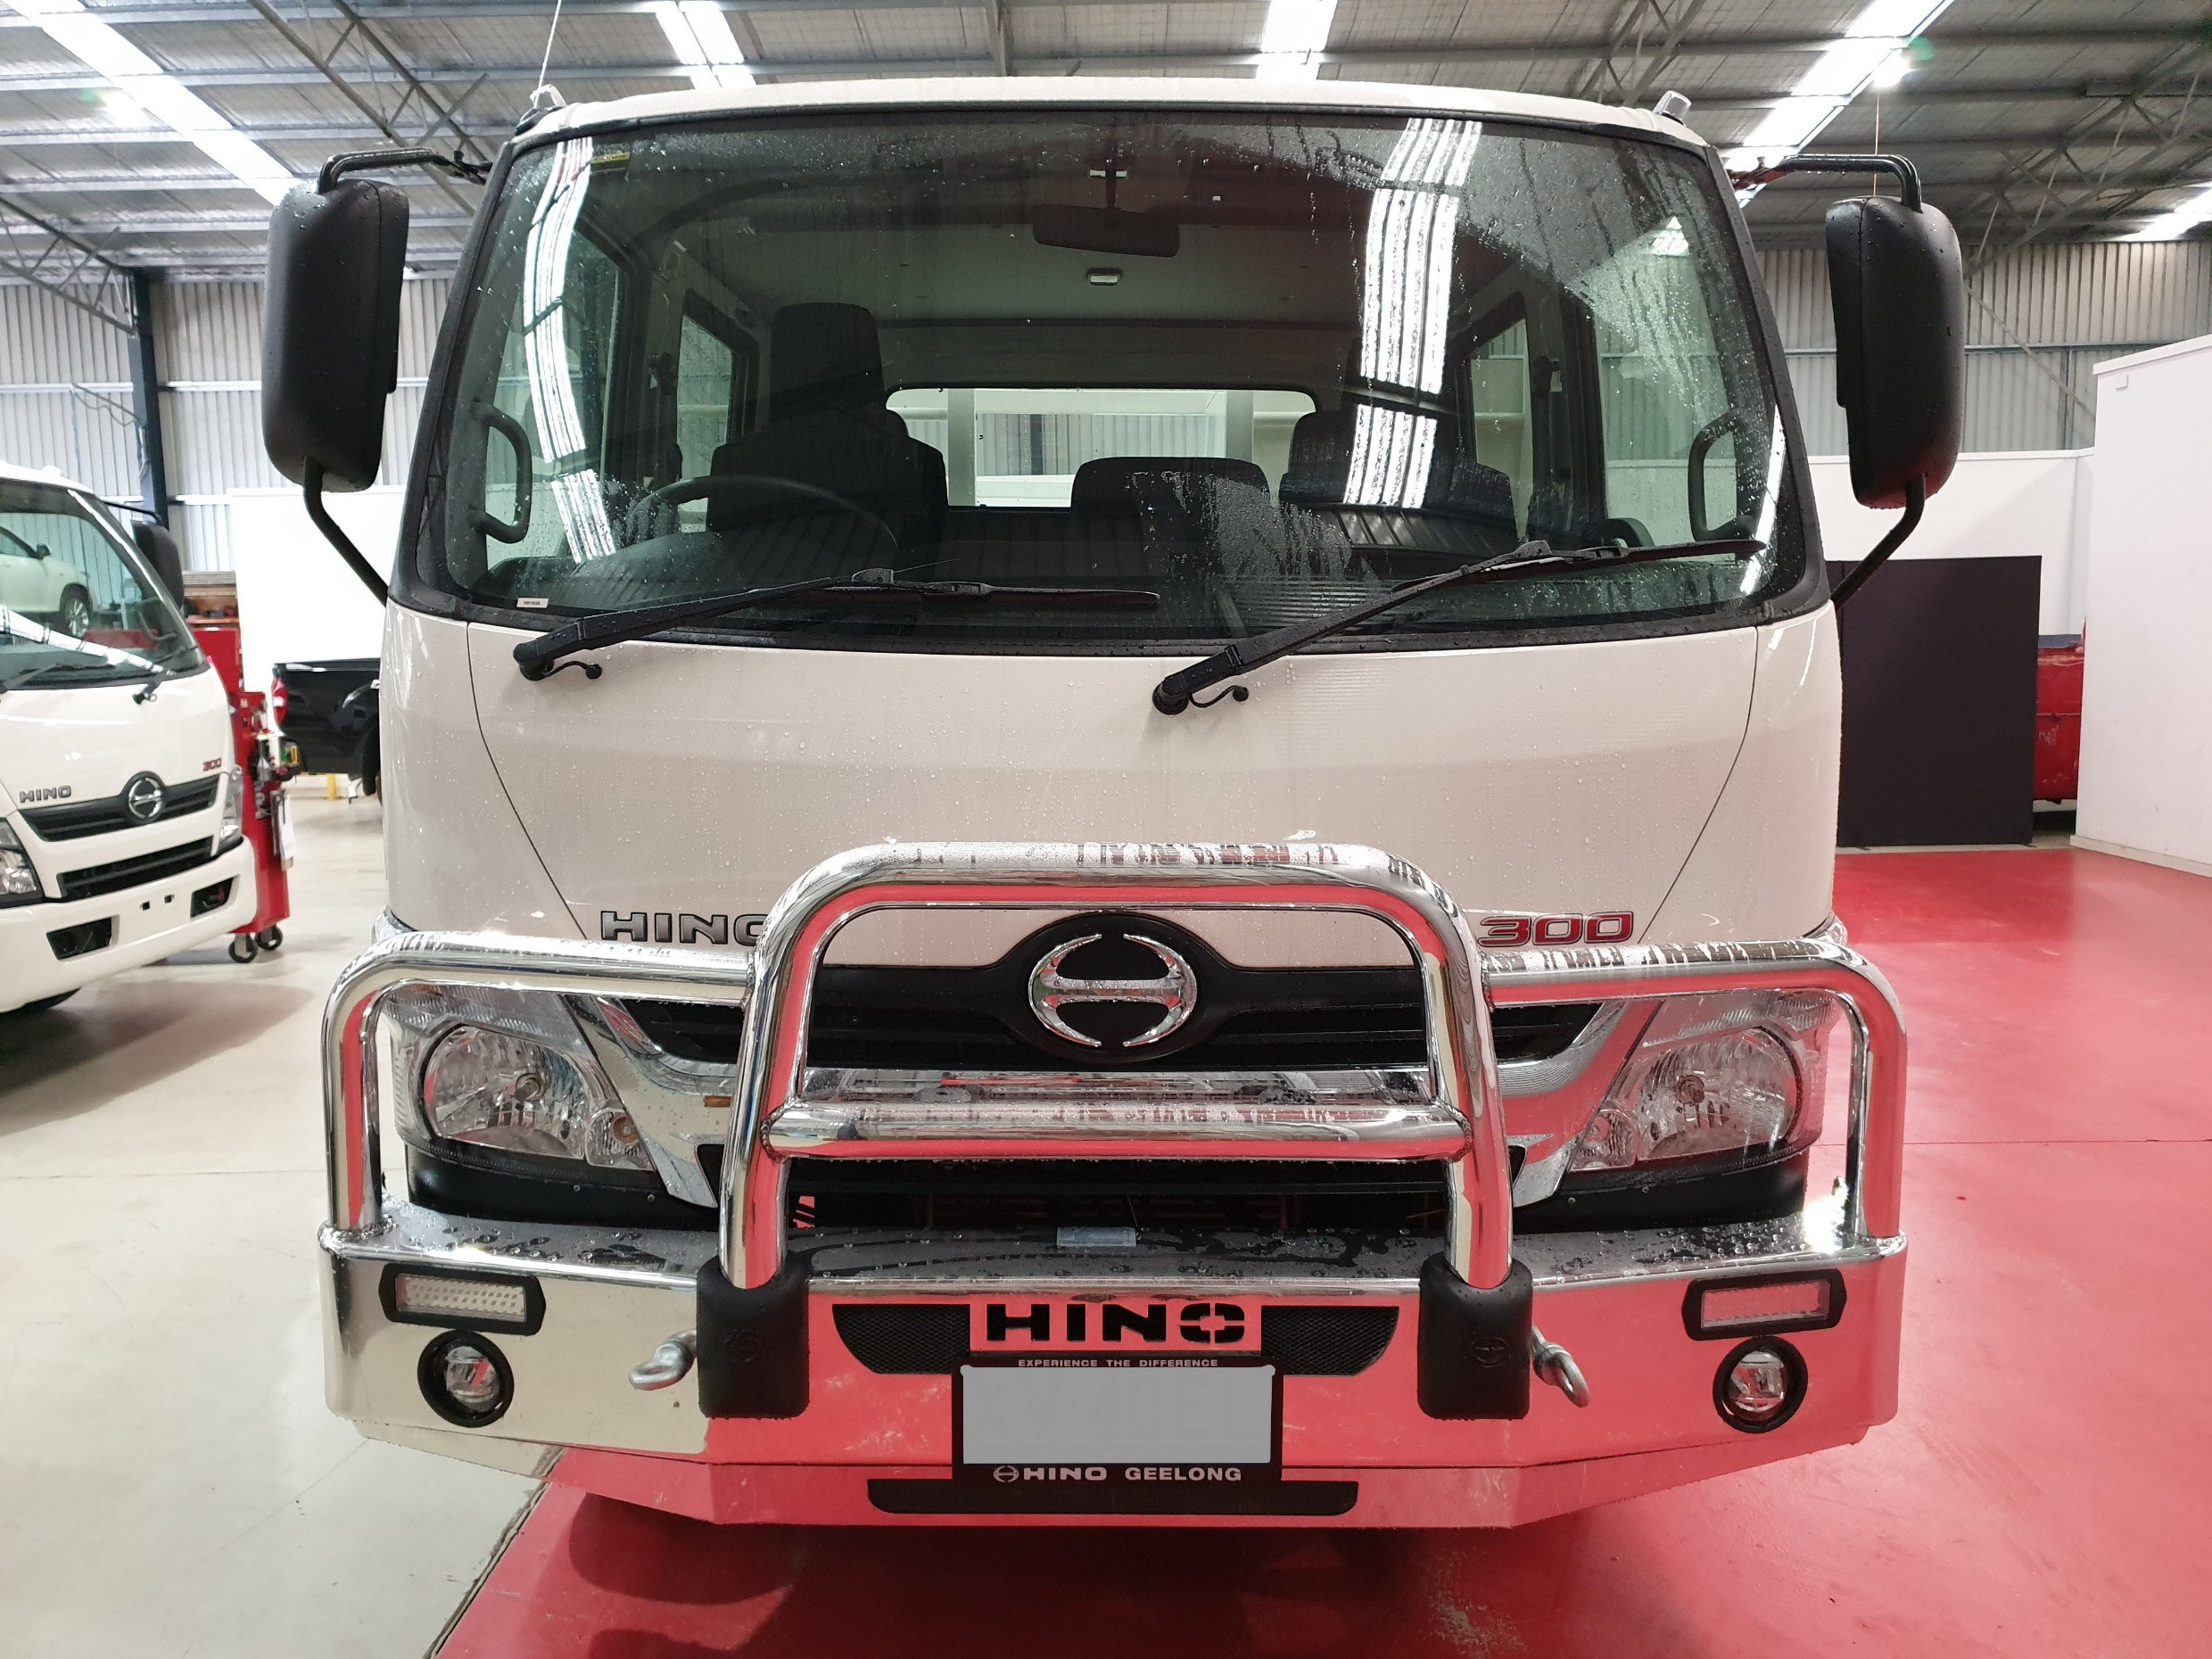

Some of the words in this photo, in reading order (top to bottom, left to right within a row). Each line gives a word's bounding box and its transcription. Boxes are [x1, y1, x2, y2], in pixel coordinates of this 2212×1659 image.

[202, 757, 222, 772] 300
[20, 785, 72, 803] HINO
[1478, 911, 1634, 947] 300
[986, 1302, 1245, 1344] HINO
[1018, 1358, 1098, 1367] EXPERIENCE
[1106, 1358, 1130, 1367] THE
[1139, 1358, 1218, 1367] DIFFERENCE
[1023, 1466, 1107, 1481] HINO
[1125, 1466, 1242, 1482] GEELONG
